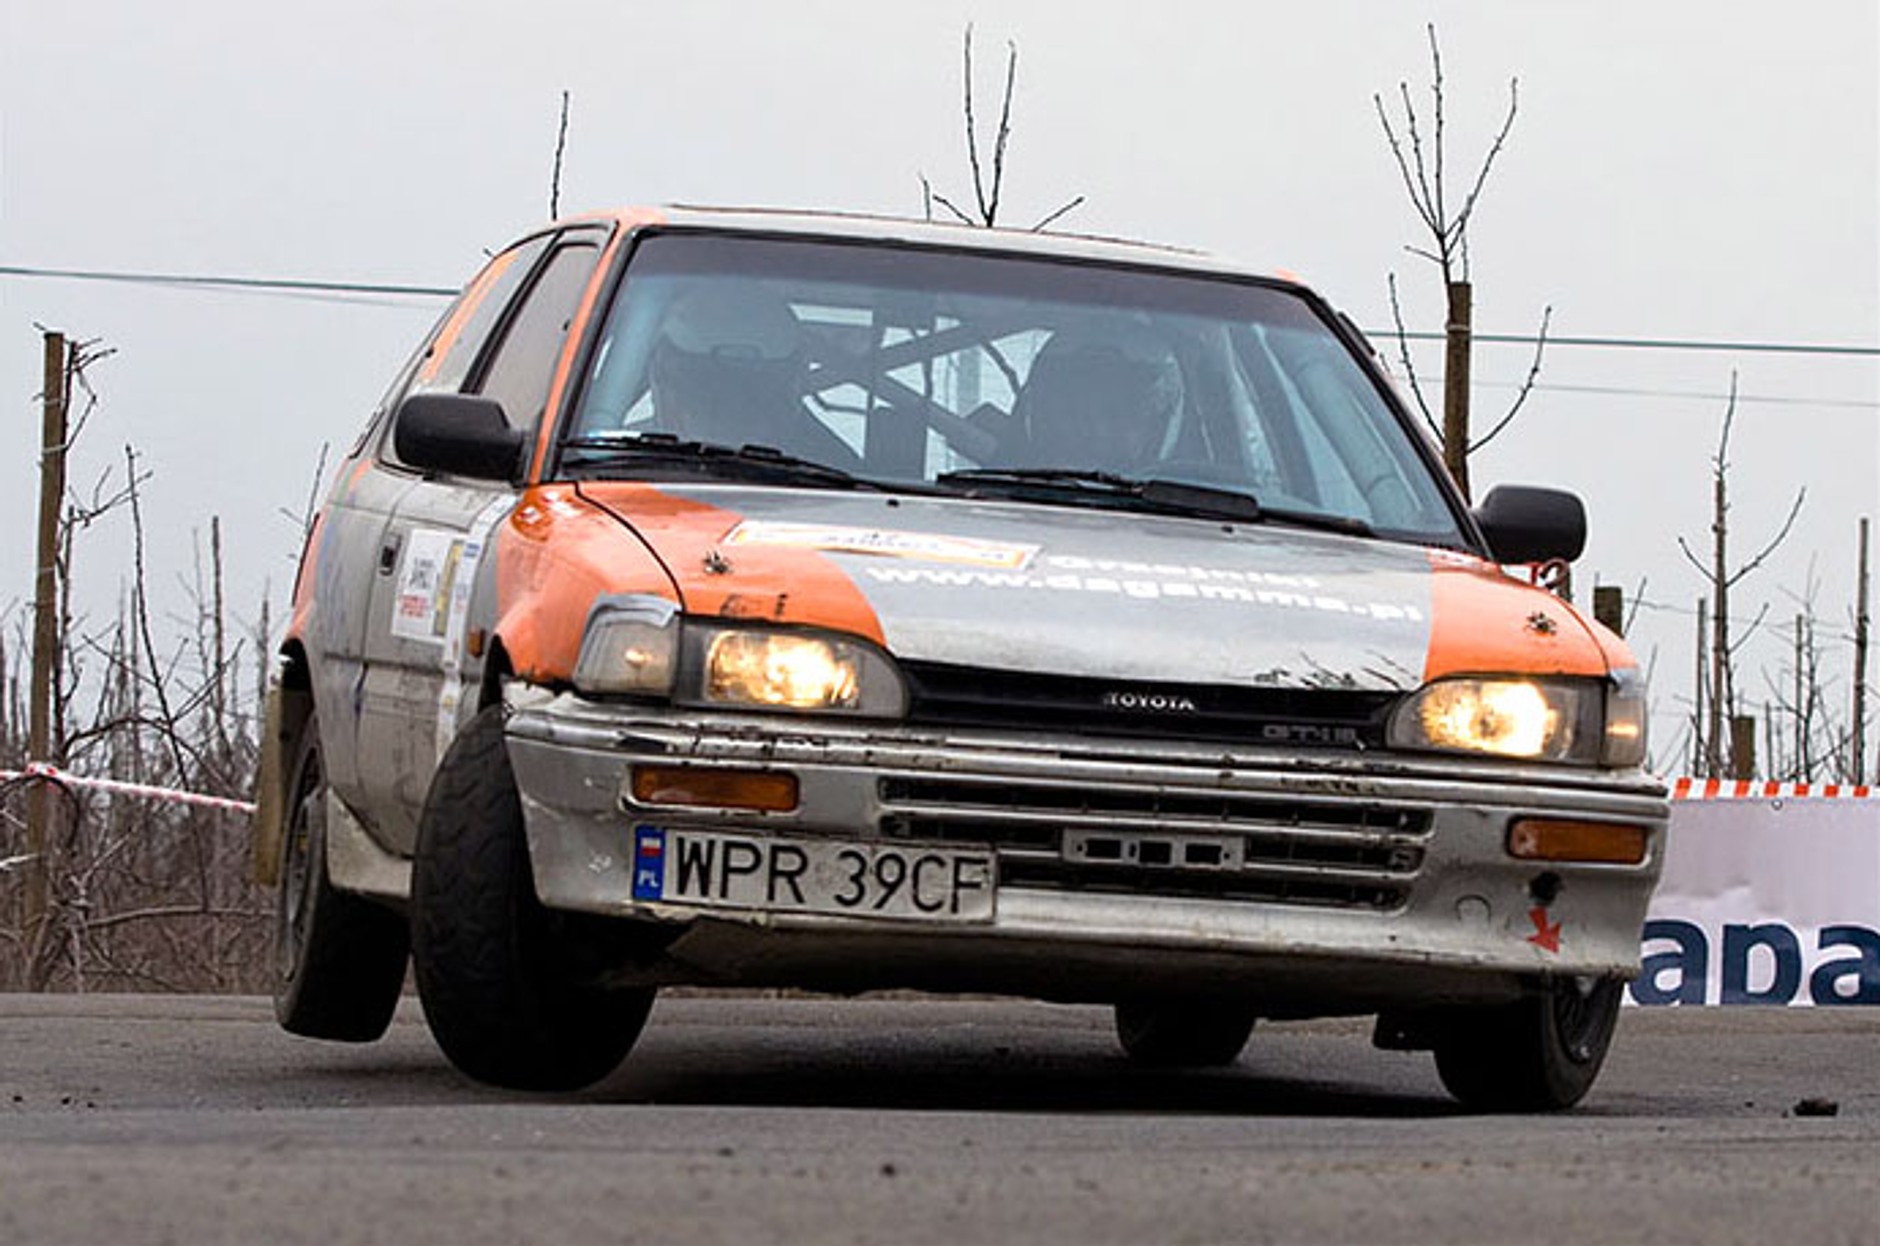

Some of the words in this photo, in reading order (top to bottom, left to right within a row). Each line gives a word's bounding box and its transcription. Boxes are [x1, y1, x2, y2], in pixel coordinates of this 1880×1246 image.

[1105, 692, 1195, 712] TOYOTA
[638, 869, 659, 888] PL
[675, 836, 806, 904] WPR
[833, 850, 989, 915] 39CF
